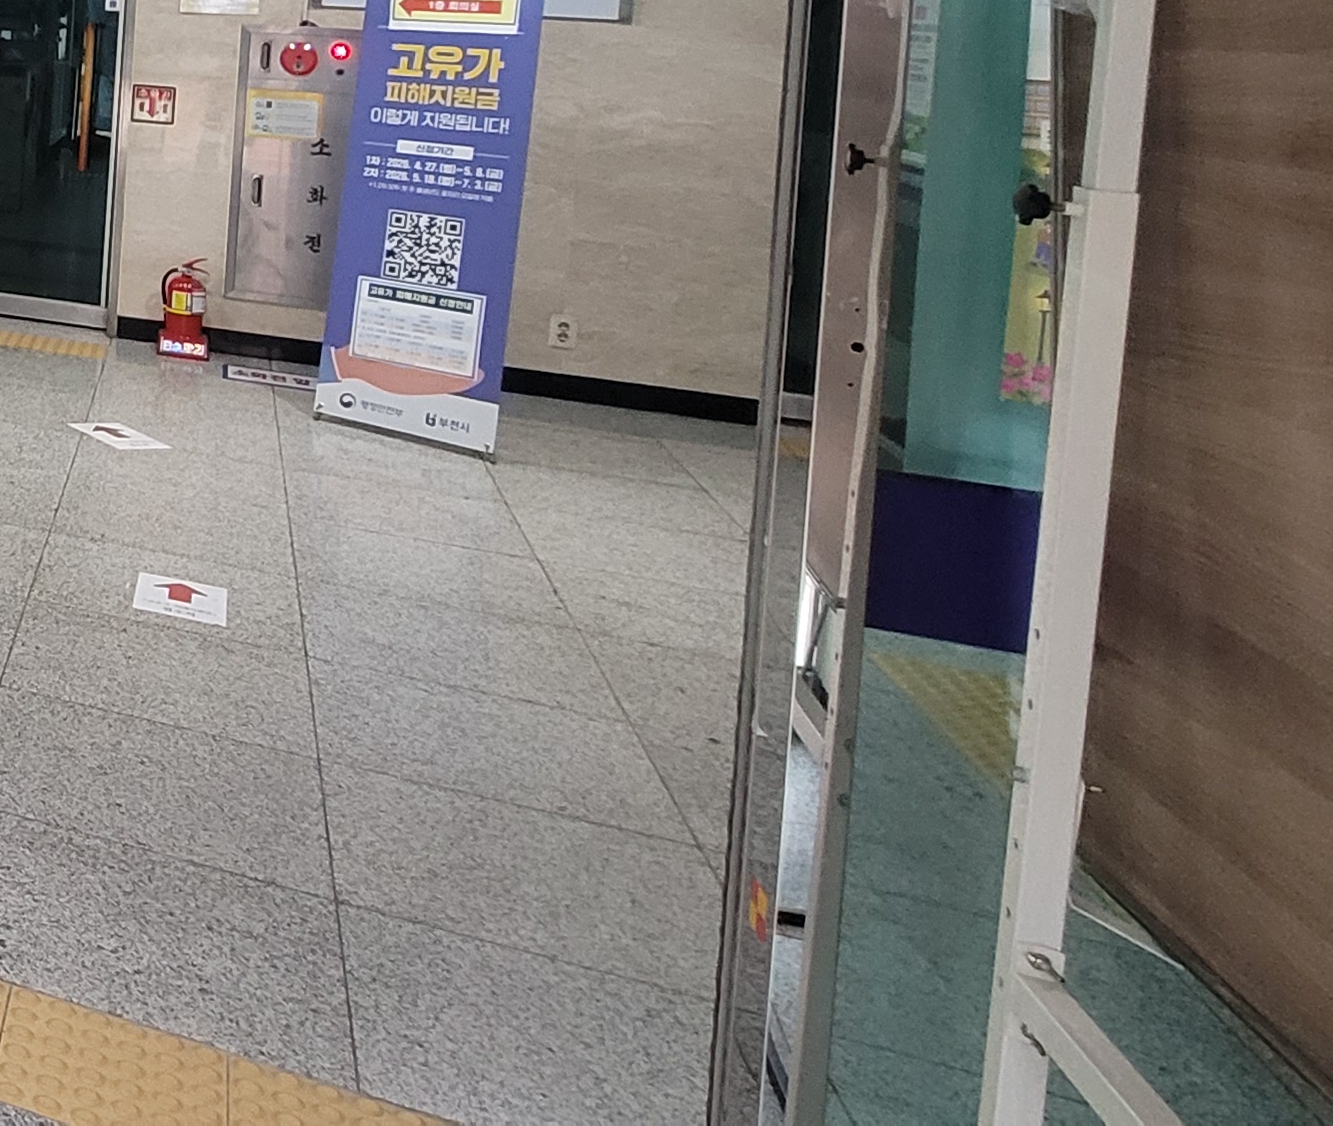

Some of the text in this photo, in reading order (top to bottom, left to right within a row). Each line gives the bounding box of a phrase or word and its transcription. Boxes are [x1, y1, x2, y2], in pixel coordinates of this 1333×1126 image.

[428, 0, 480, 12] 1층 회의실
[387, 43, 506, 83] 고유가
[384, 81, 502, 112] 피해지원금
[370, 107, 510, 135] 이렇게 지원됩니다!
[416, 144, 455, 156] 신청기간
[370, 286, 393, 297] 고유가
[439, 417, 470, 434] 부천시
